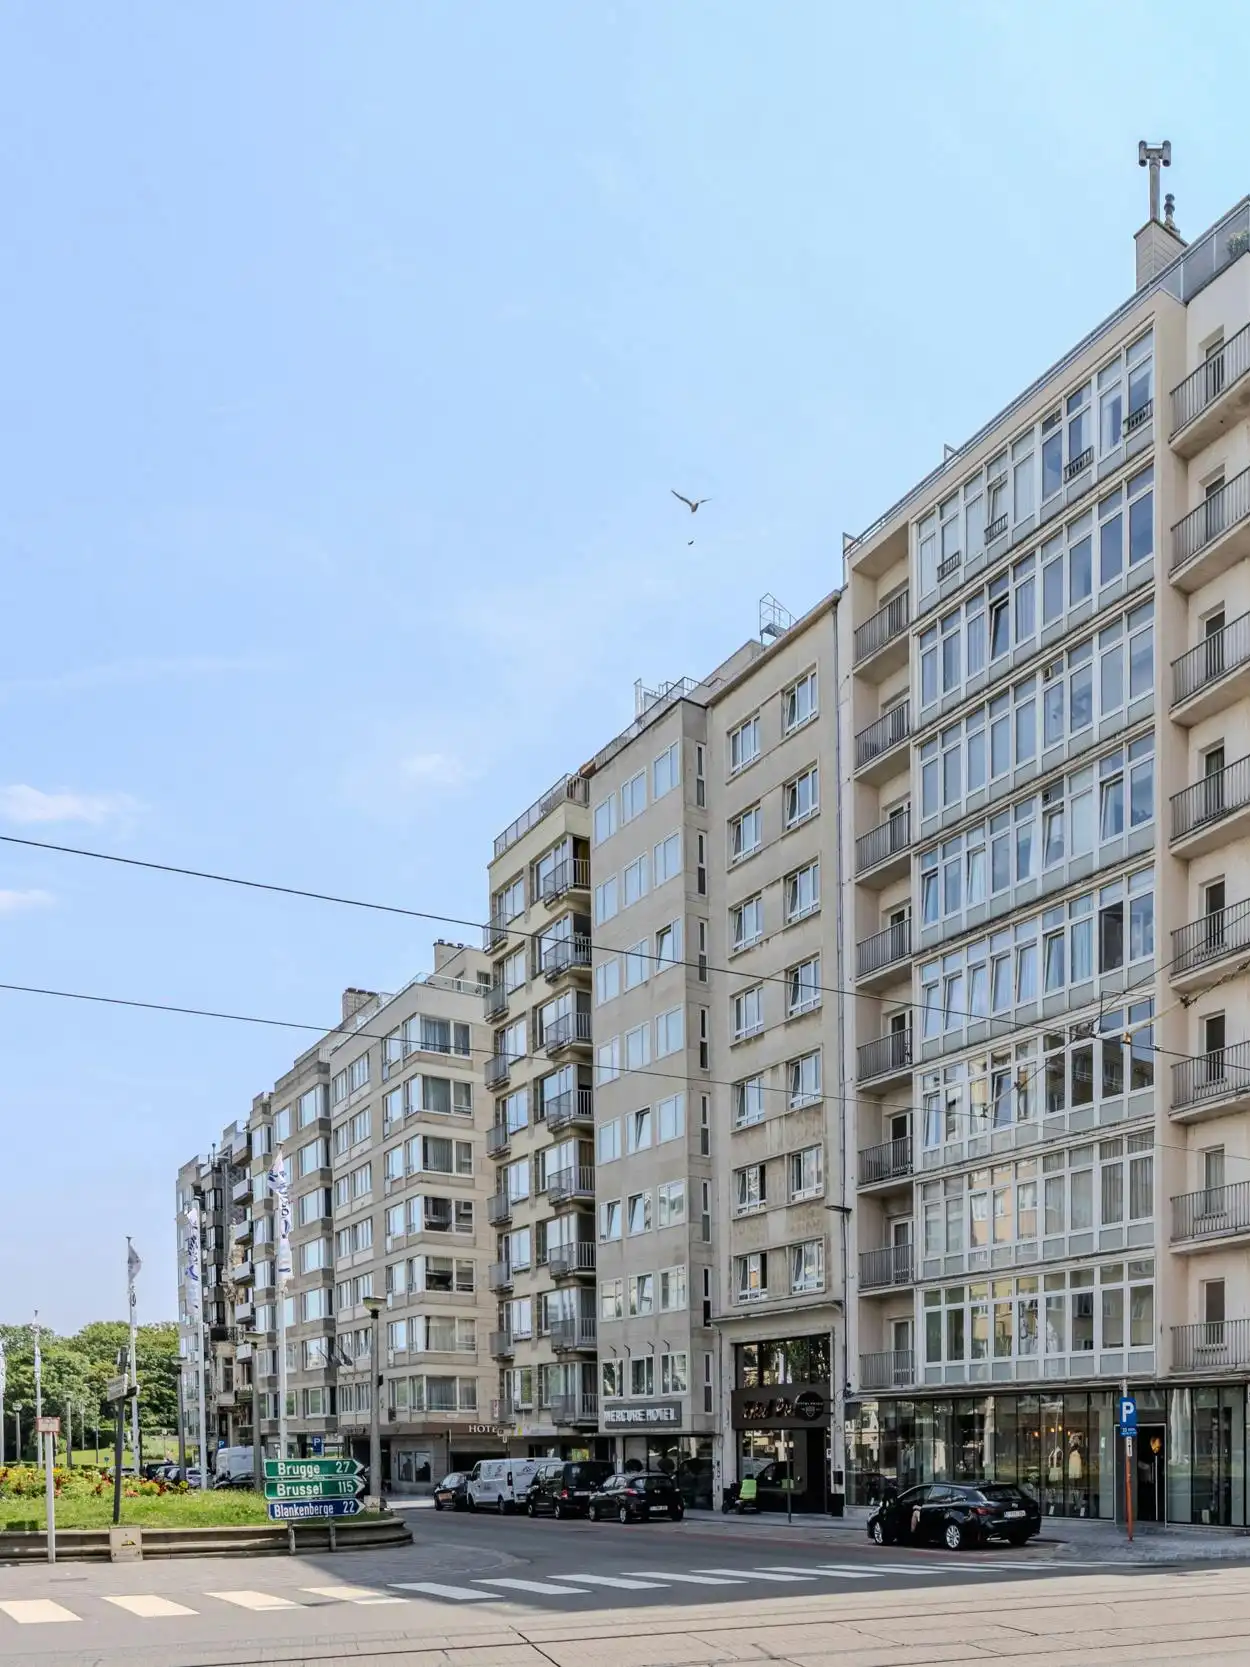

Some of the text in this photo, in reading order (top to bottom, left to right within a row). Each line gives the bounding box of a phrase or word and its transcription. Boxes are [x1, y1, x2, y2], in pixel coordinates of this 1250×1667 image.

[604, 1407, 675, 1422] MERCURE HOTEL
[1122, 1401, 1135, 1423] P
[468, 1424, 502, 1434] HOTE
[277, 1460, 350, 1478] Brugge 27
[276, 1480, 354, 1497] Brussel 115
[274, 1500, 355, 1518] Blankenberge 22
